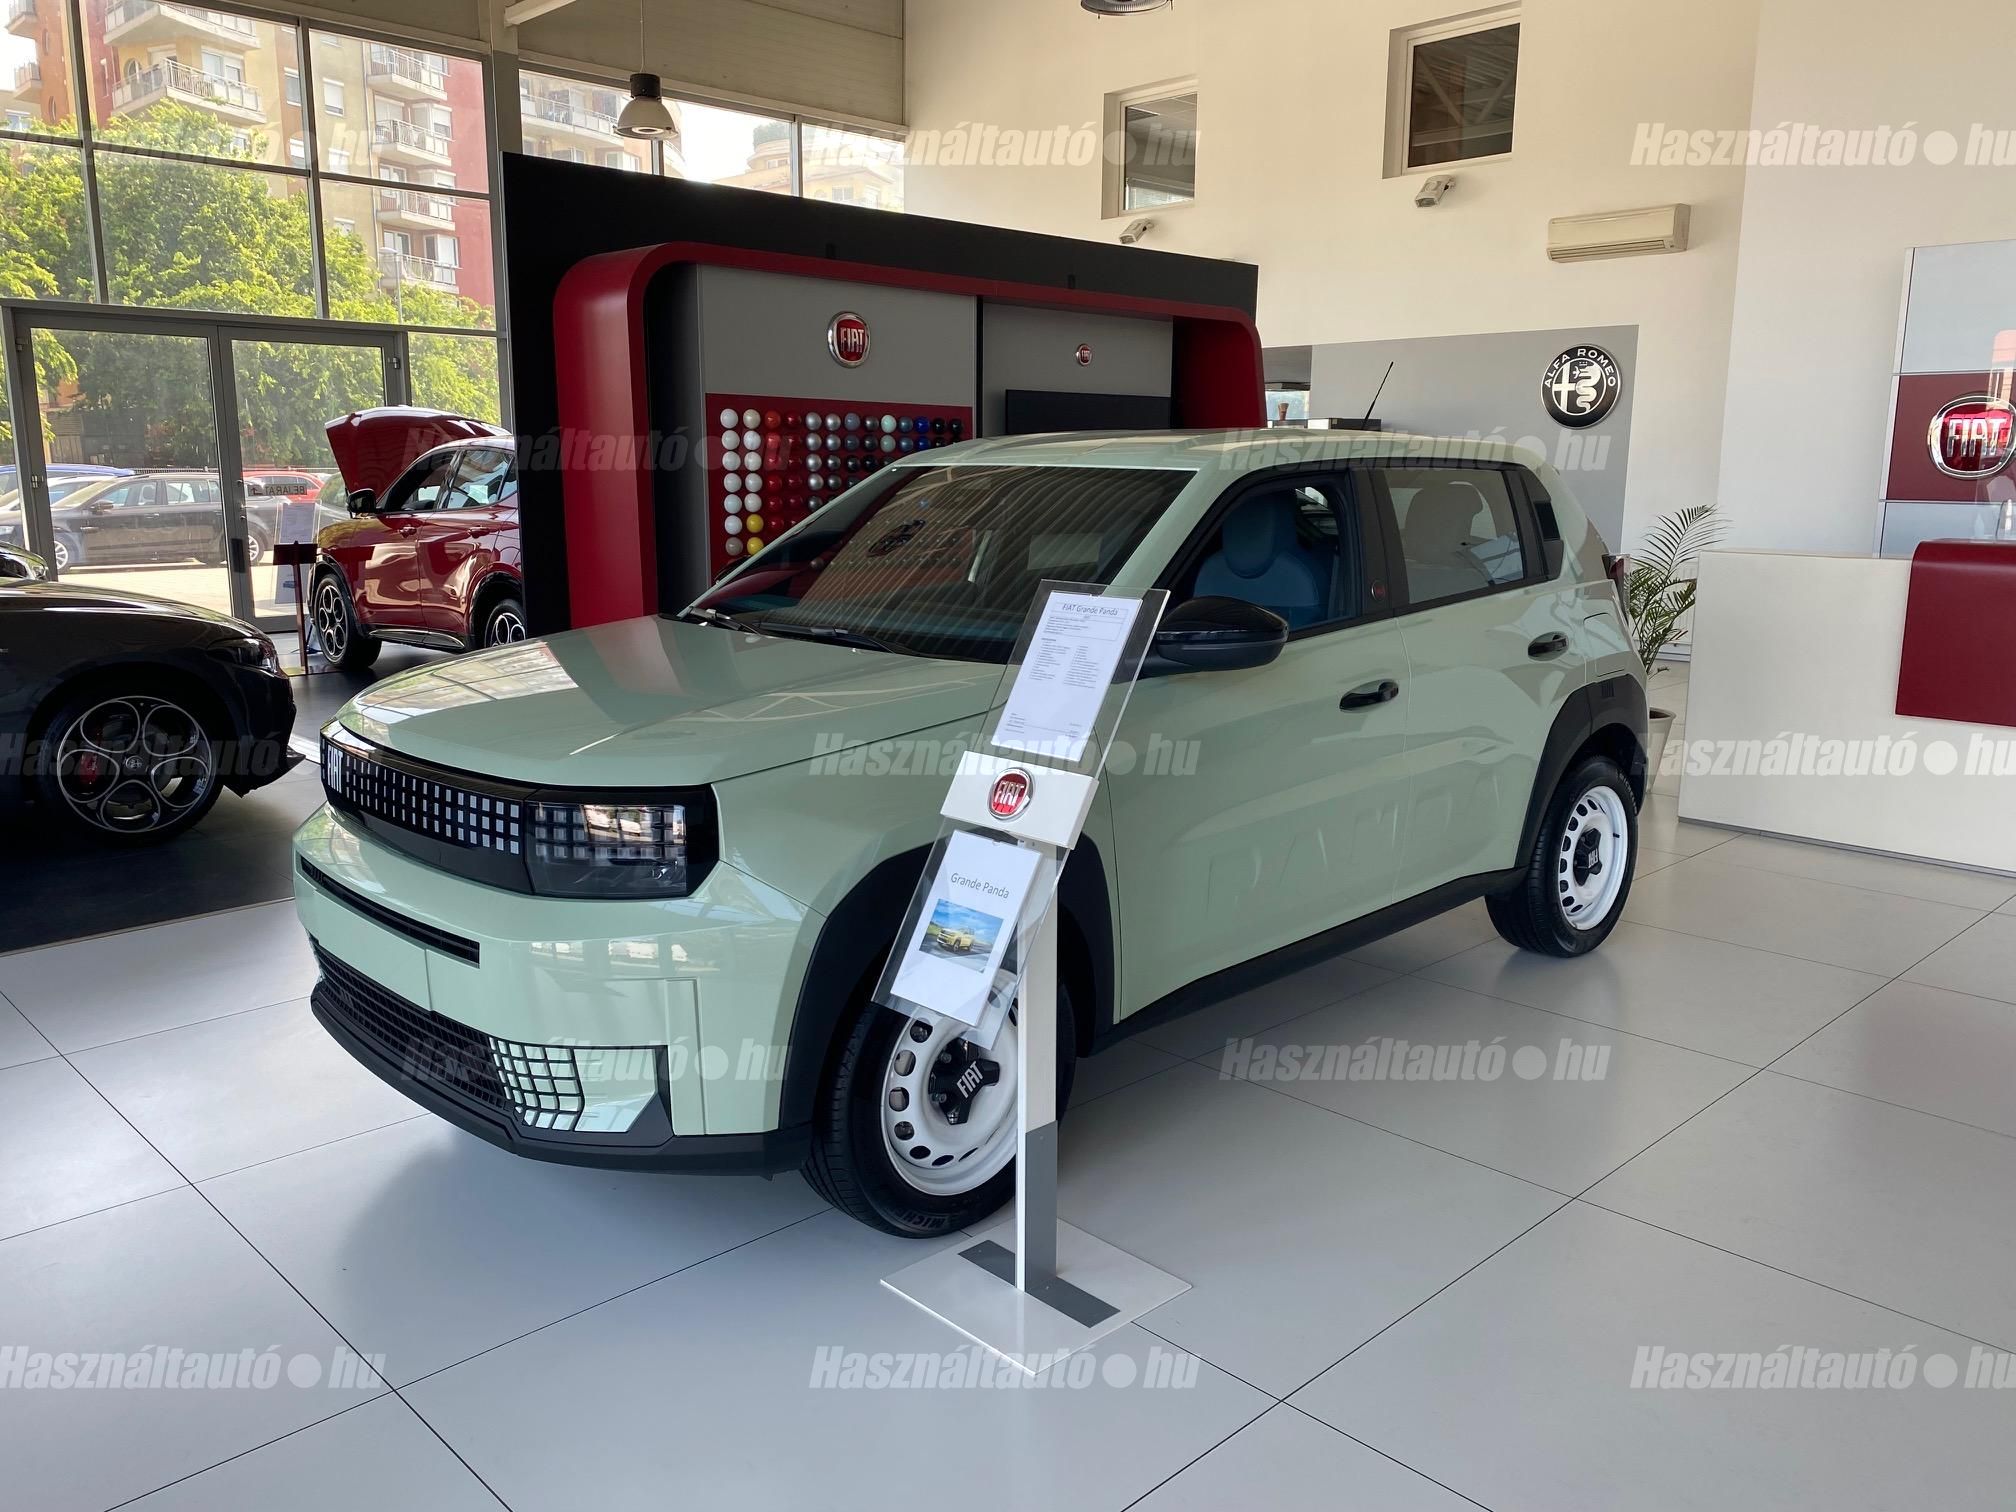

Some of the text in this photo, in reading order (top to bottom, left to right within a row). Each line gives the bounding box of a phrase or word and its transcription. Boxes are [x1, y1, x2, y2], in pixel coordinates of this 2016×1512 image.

[840, 327, 864, 352] FIAT
[1544, 348, 1616, 388] ALFA ROMEO
[1946, 418, 2007, 457] FIAT
[1062, 603, 1076, 611] FIAT
[1076, 605, 1098, 614] Grande
[1099, 607, 1118, 616] Panda
[327, 744, 343, 794] FIAT
[994, 780, 1025, 807] FIAT
[950, 872, 1010, 899] Grande Panda
[956, 1060, 983, 1098] FIAT
